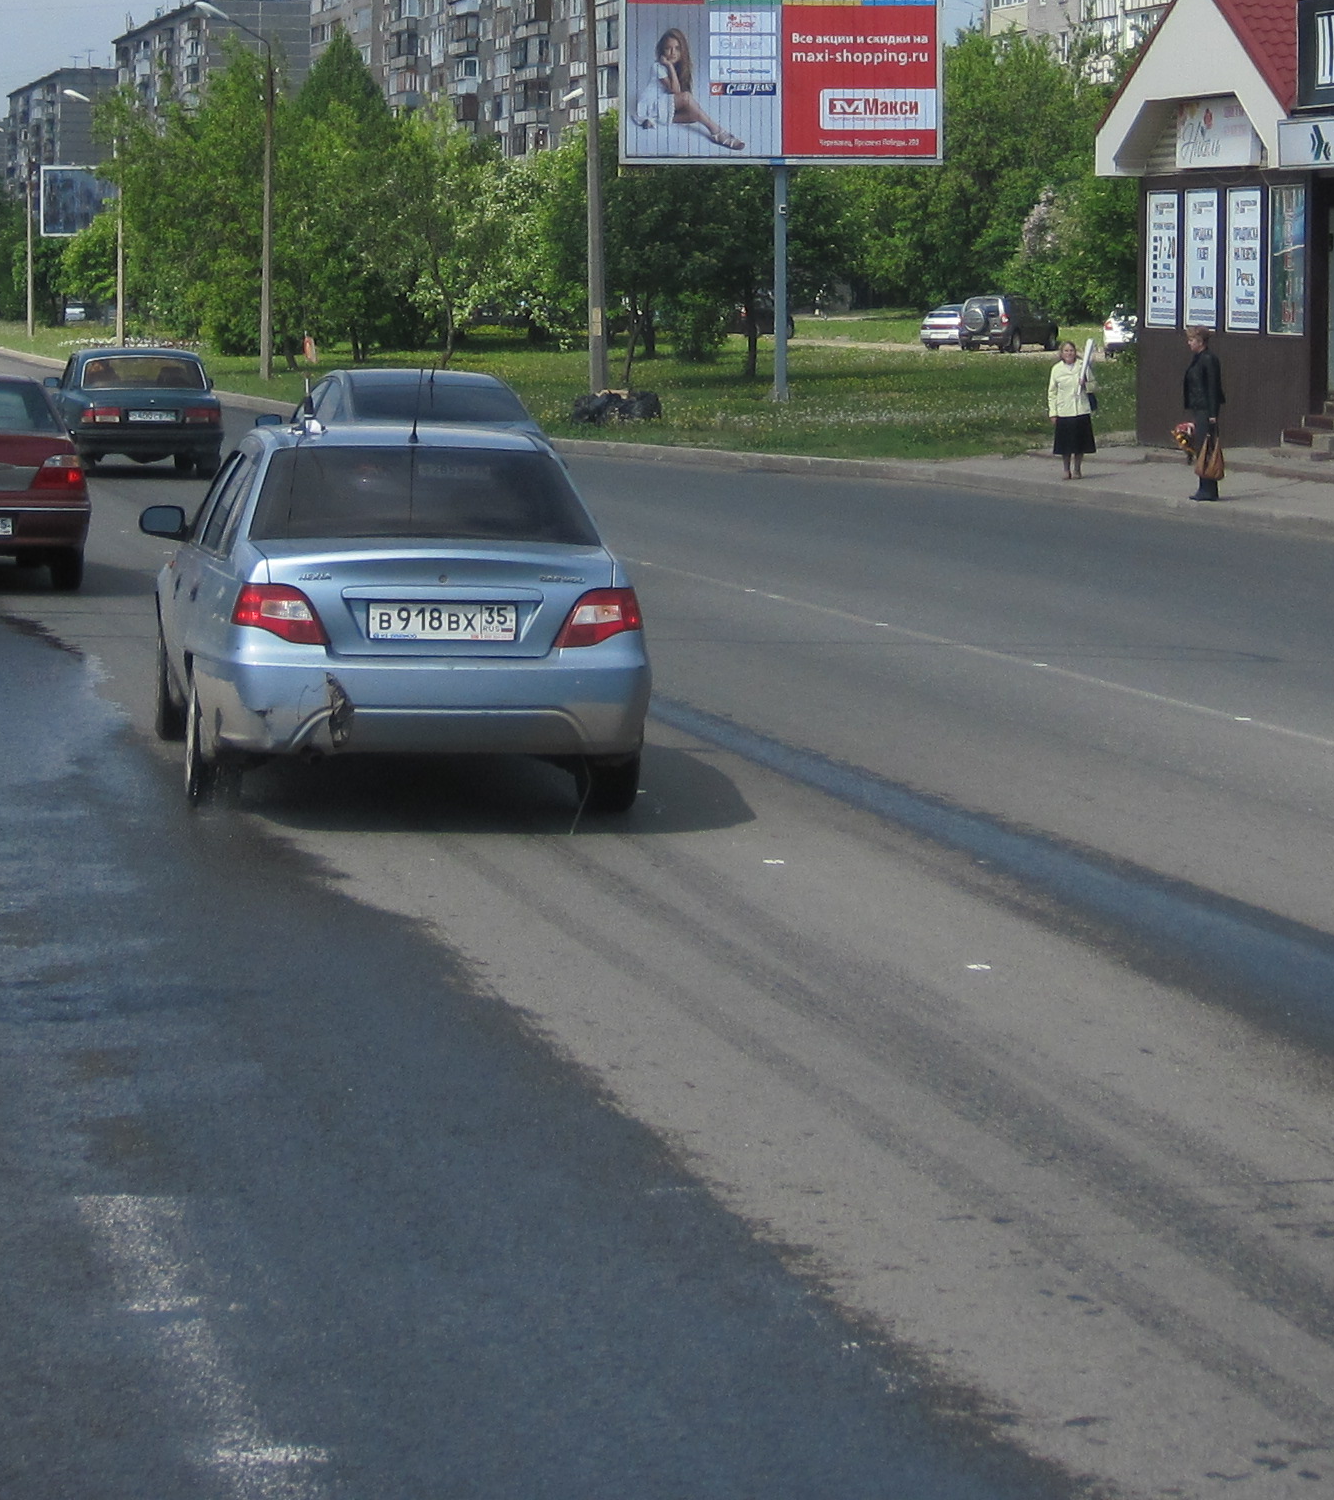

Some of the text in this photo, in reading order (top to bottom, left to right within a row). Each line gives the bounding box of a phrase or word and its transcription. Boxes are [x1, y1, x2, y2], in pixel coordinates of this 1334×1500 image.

[791, 32, 929, 46] Все акции и скидки на
[792, 49, 929, 65] maxi-shopping.ru
[864, 99, 918, 115] Макси
[379, 607, 507, 631] В918ВХ 35
